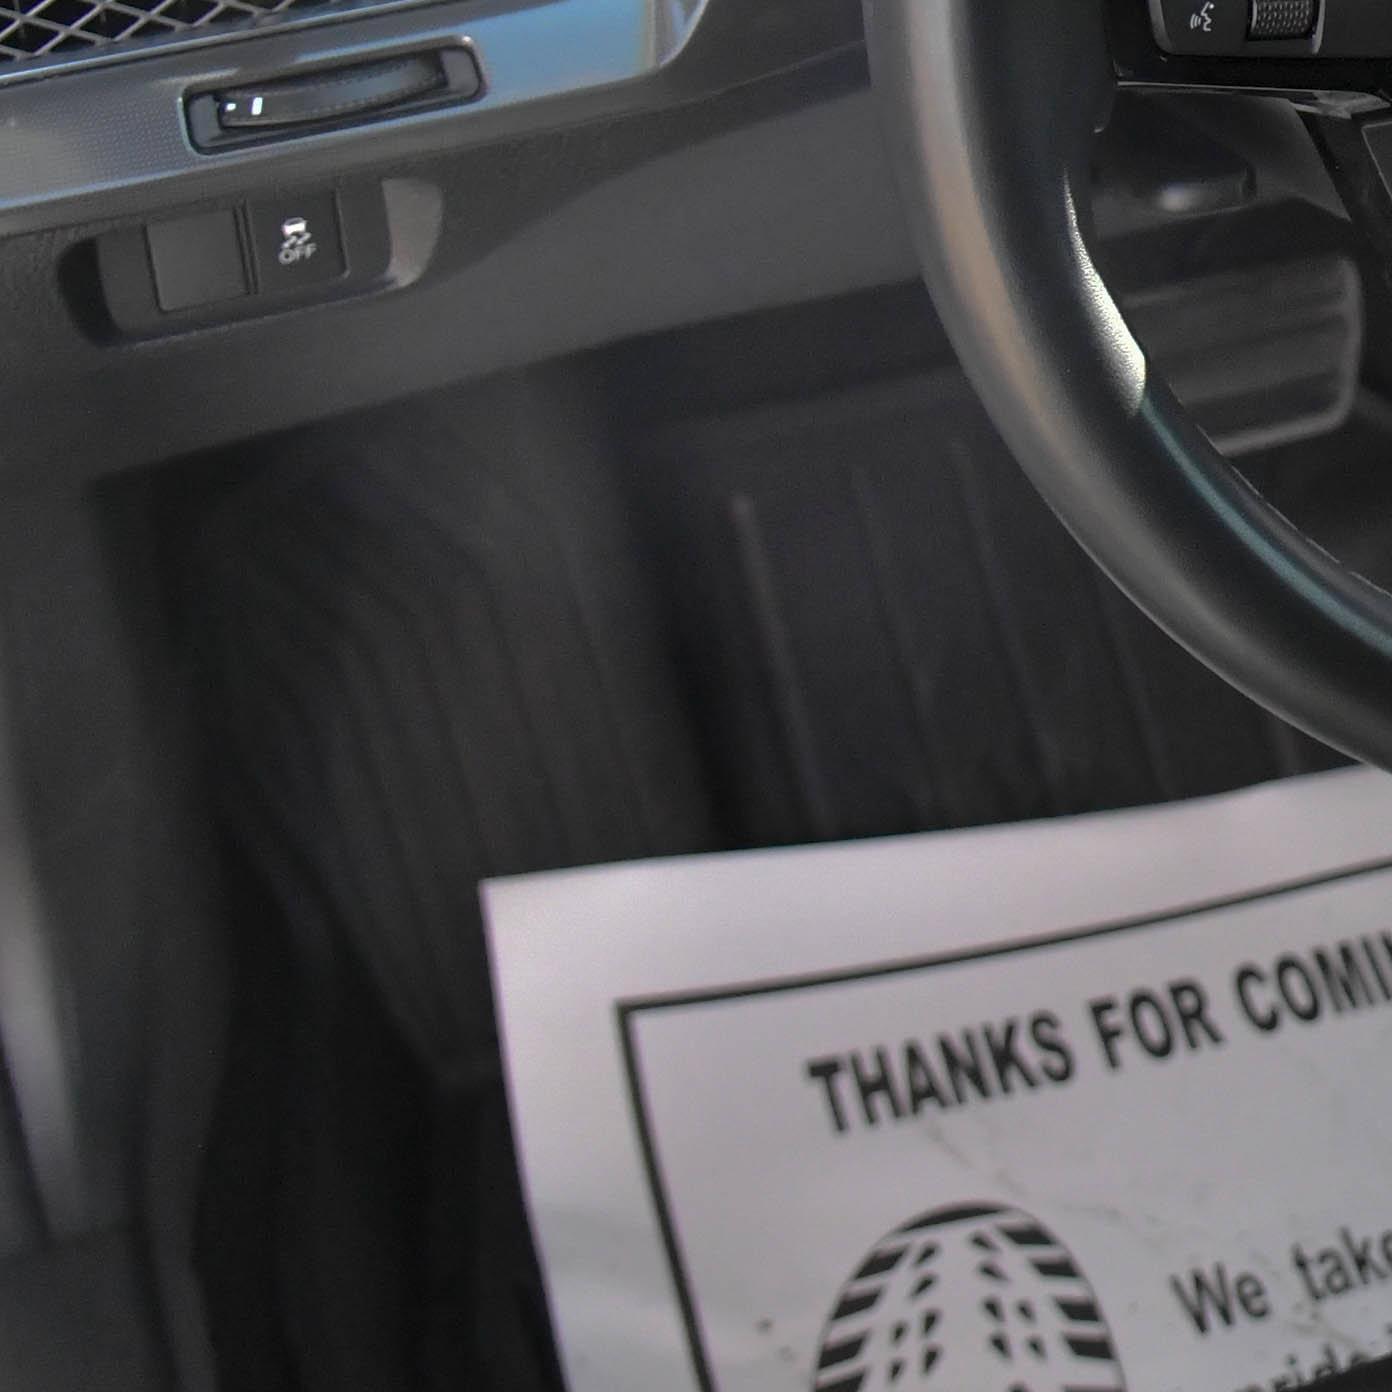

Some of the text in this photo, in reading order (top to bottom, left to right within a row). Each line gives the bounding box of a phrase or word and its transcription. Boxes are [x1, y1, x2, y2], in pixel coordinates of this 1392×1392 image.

[278, 242, 318, 265] OFF
[808, 1010, 1078, 1138] THANKS
[1086, 976, 1225, 1072] FOR
[1168, 1260, 1272, 1336] We
